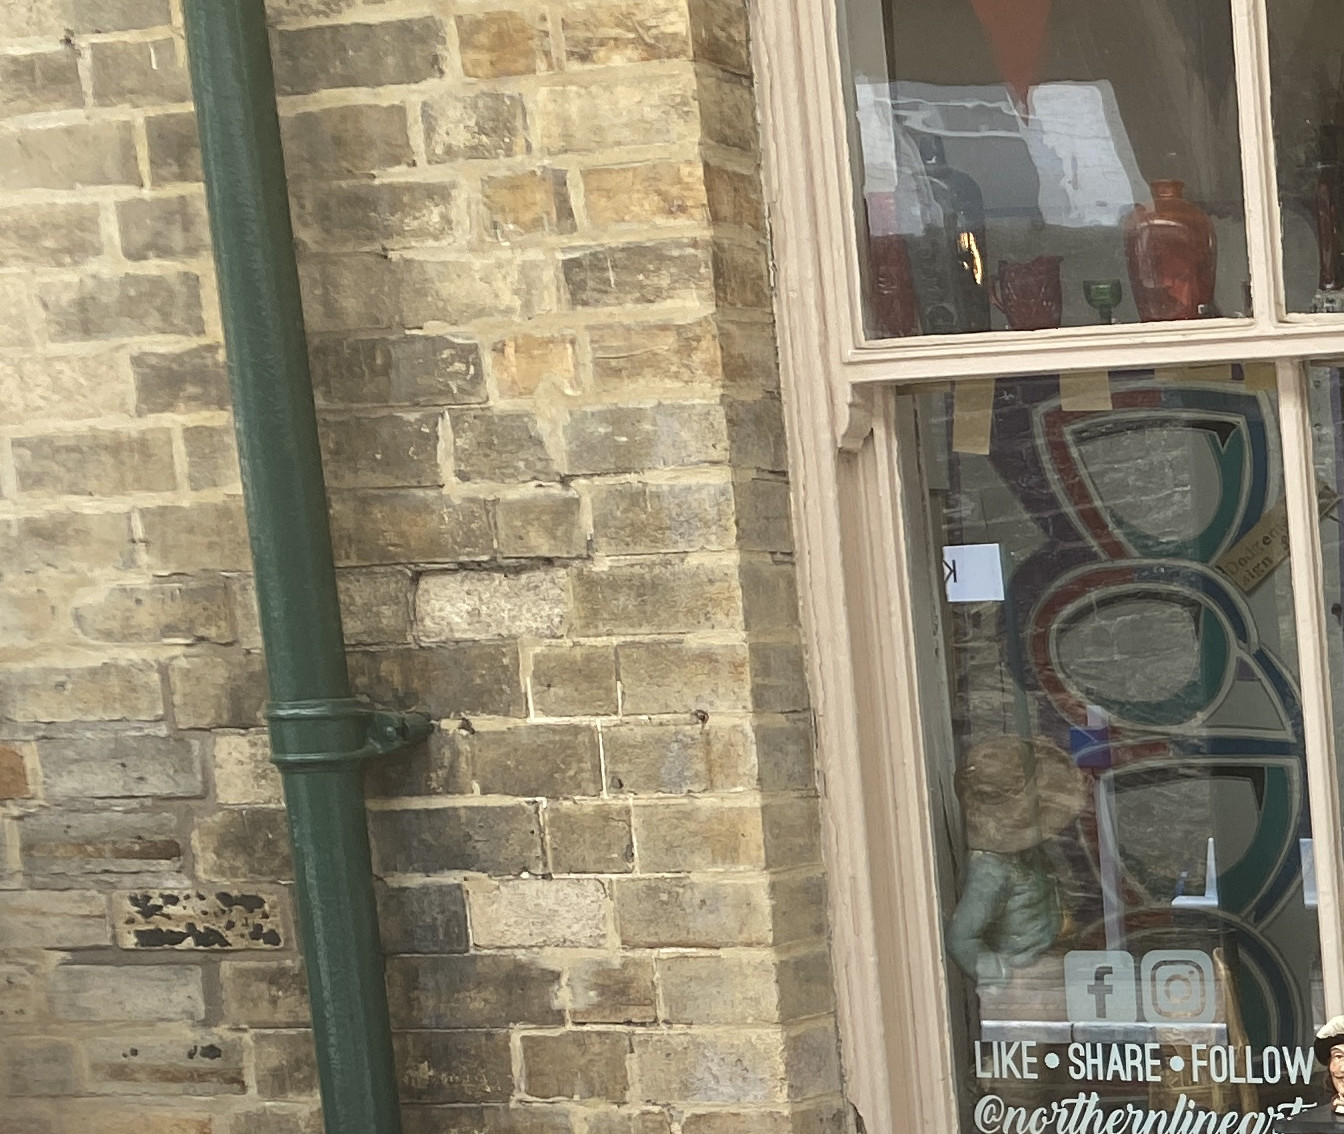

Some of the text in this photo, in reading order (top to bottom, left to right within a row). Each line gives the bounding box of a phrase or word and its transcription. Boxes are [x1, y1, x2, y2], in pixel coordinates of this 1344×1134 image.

[974, 1040, 1315, 1085] LIKE SHARE FOLLOW
